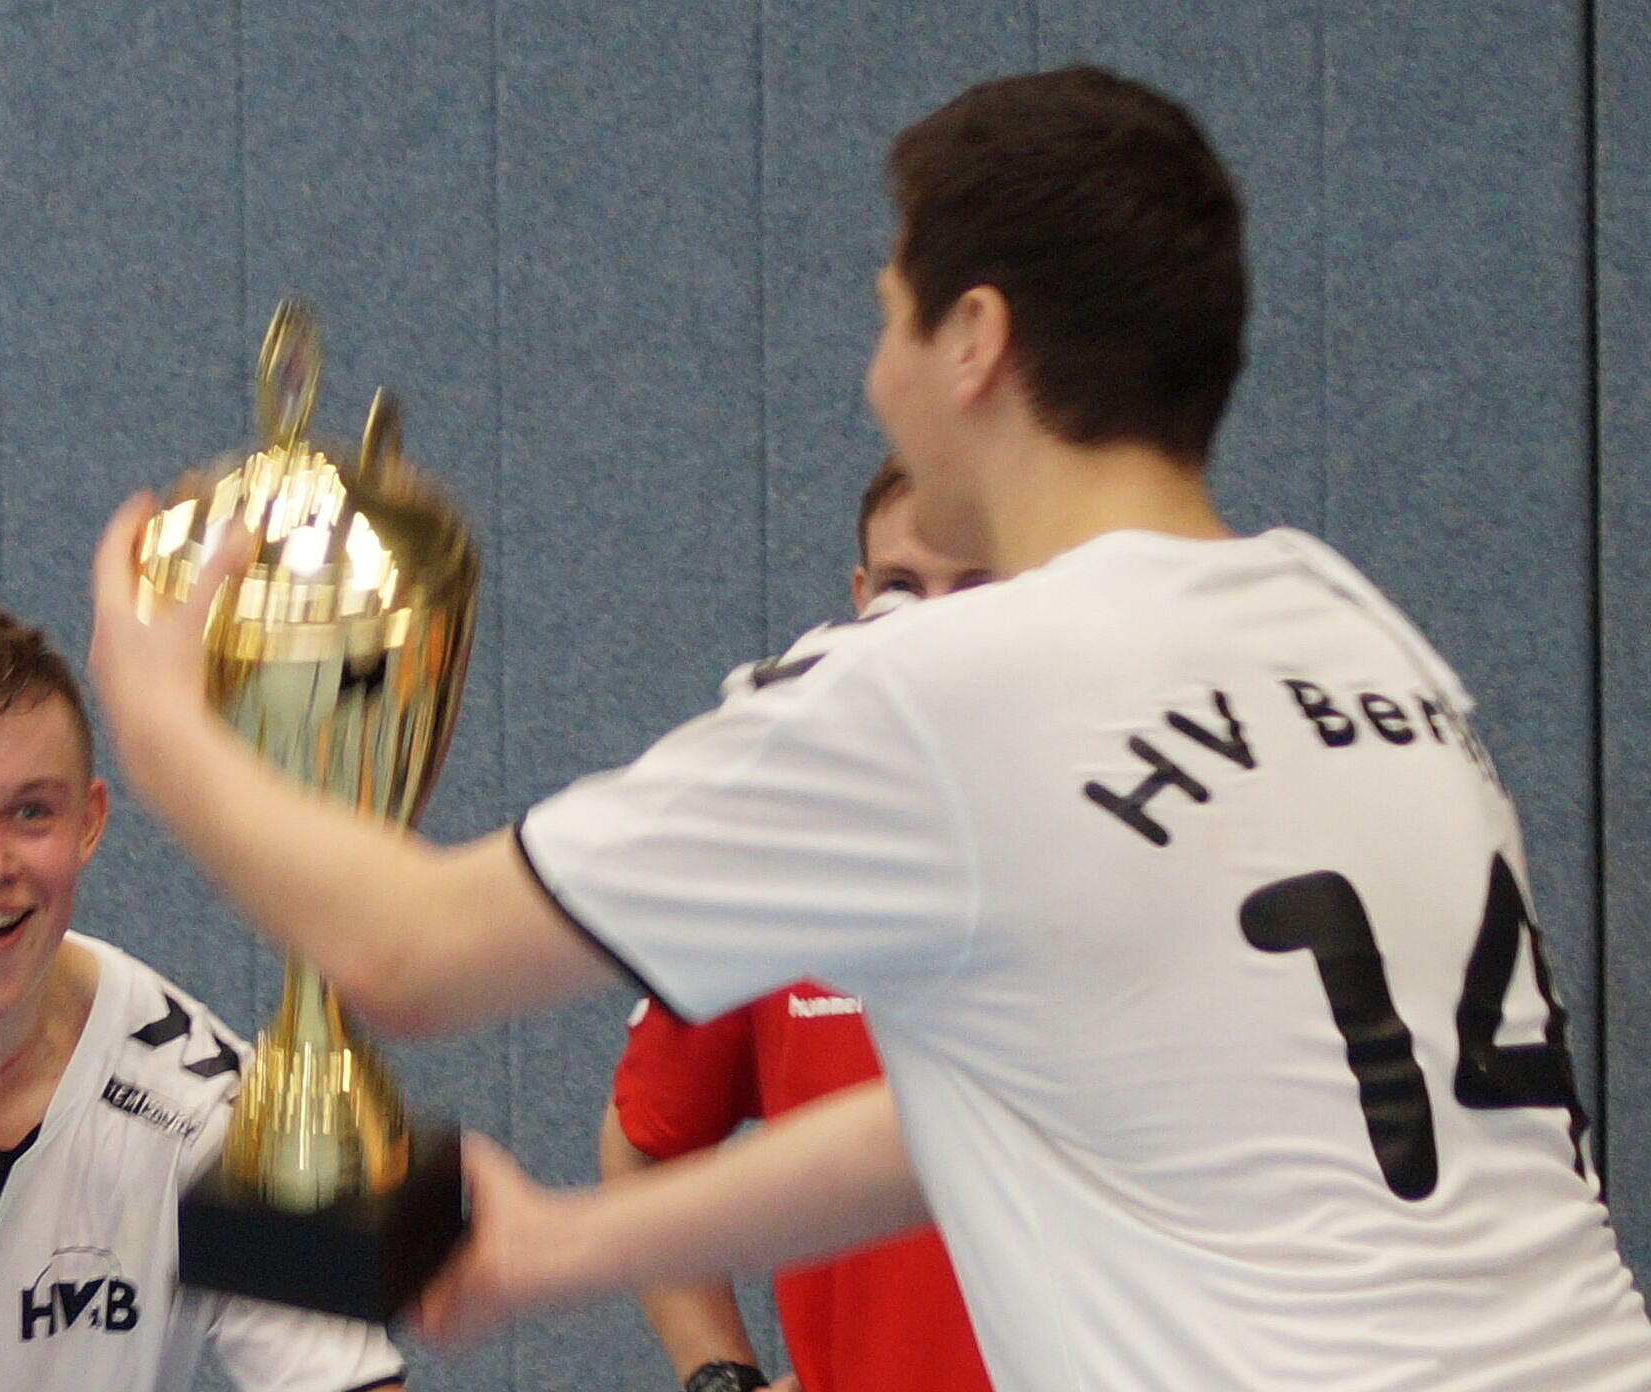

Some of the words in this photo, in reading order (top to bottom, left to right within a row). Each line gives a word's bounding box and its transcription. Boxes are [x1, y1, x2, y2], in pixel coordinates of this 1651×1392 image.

[1083, 687, 1257, 847] HV
[1281, 678, 1451, 748] Ber
[1238, 851, 1591, 1202] 14
[19, 1276, 141, 1341] HVB
